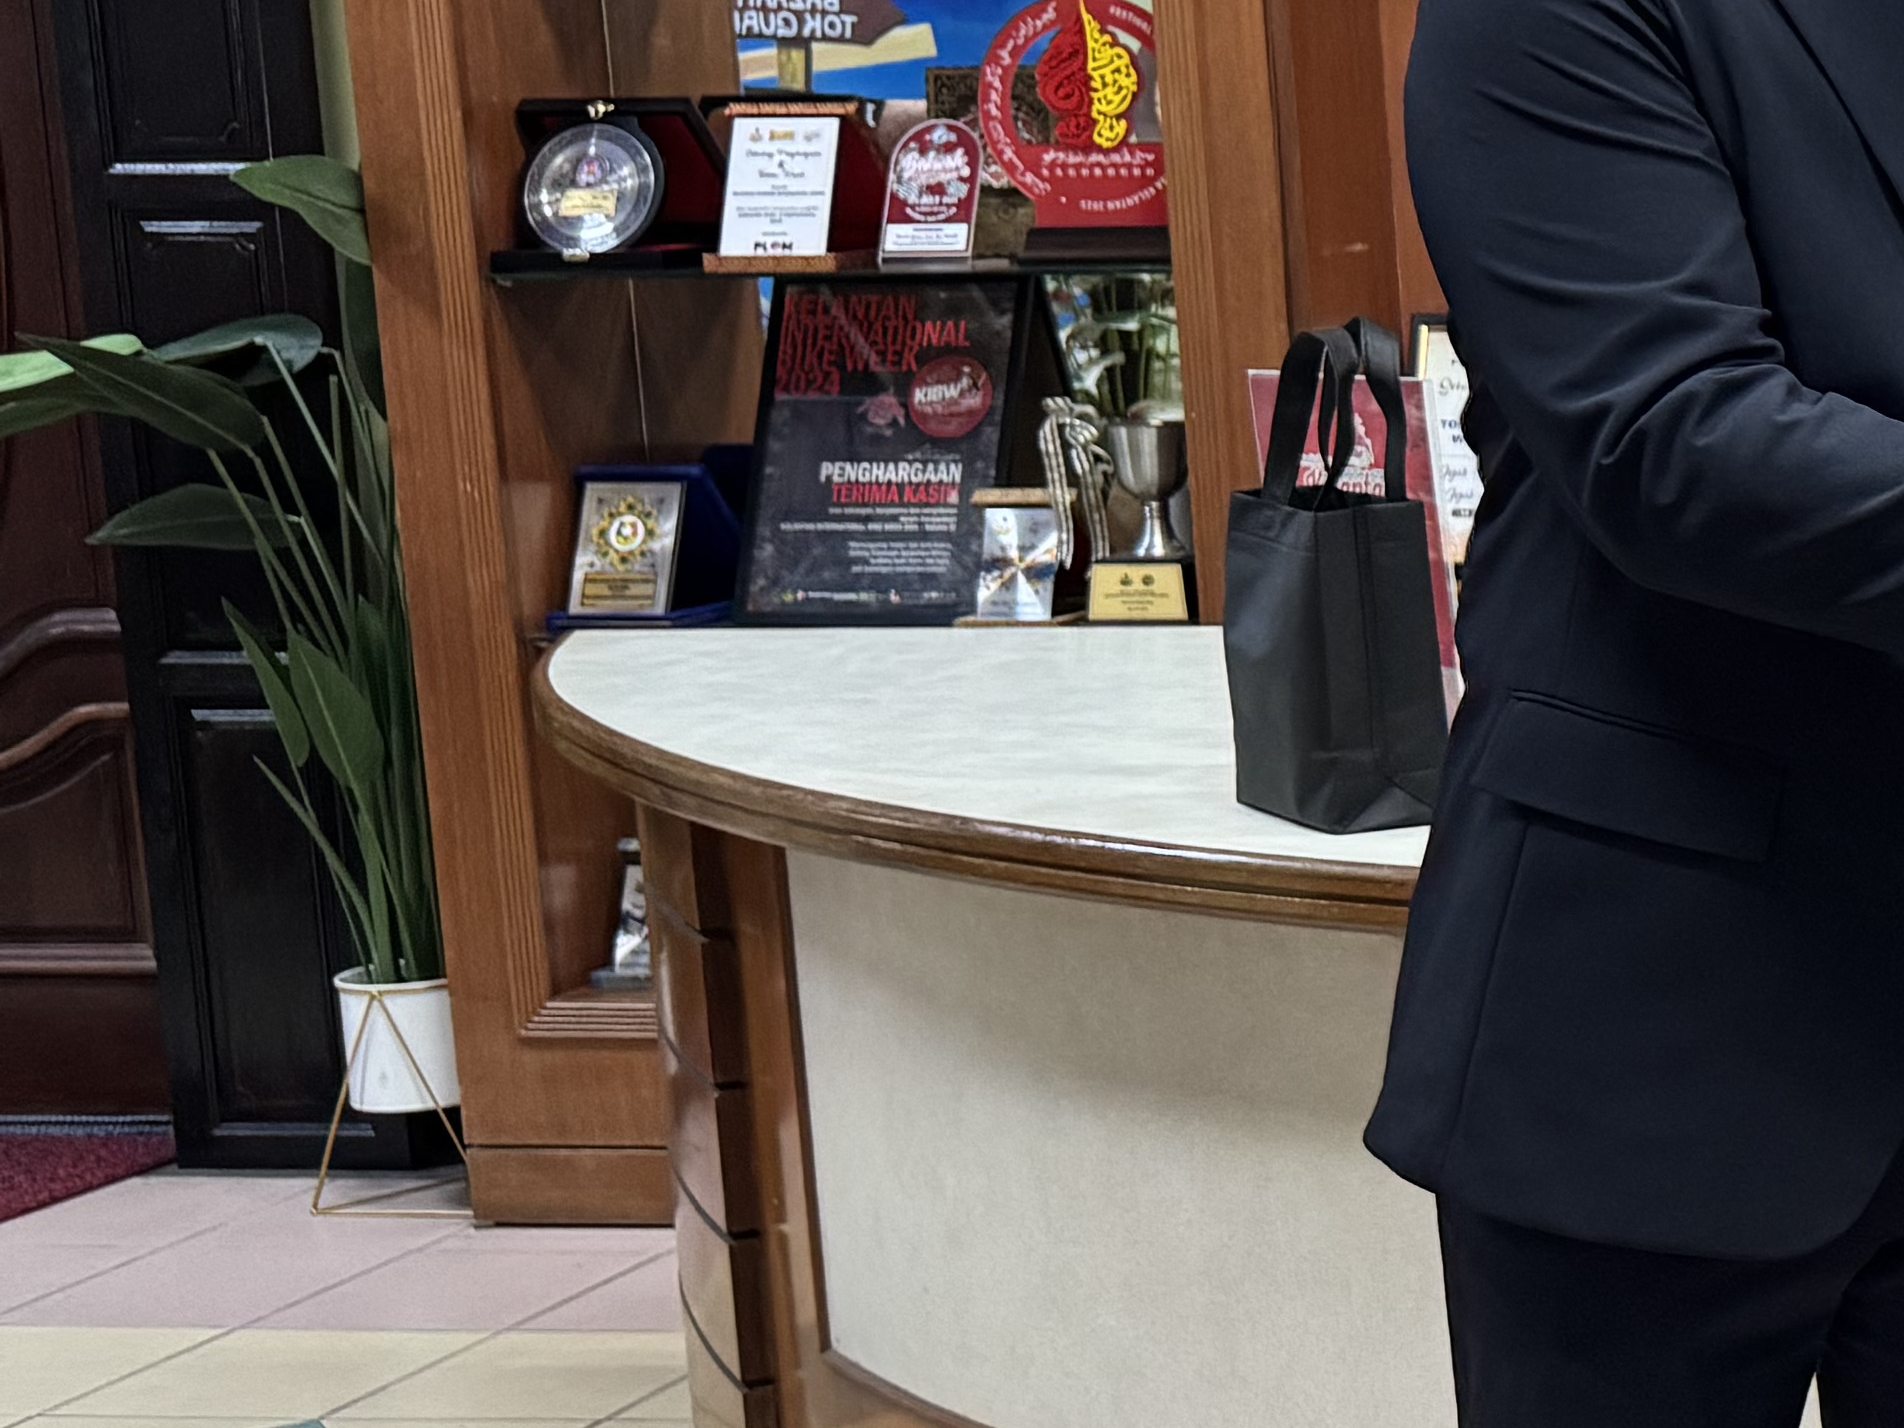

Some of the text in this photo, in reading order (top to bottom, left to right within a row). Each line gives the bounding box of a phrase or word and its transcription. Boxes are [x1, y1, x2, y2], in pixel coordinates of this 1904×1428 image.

[785, 293, 917, 322] KELANTAN
[779, 320, 971, 351] INTERNATIONAL
[776, 344, 920, 375] BIKE WEEK
[820, 461, 963, 484] PENGHARGAAN
[831, 483, 960, 505] TERIMA KASIH
